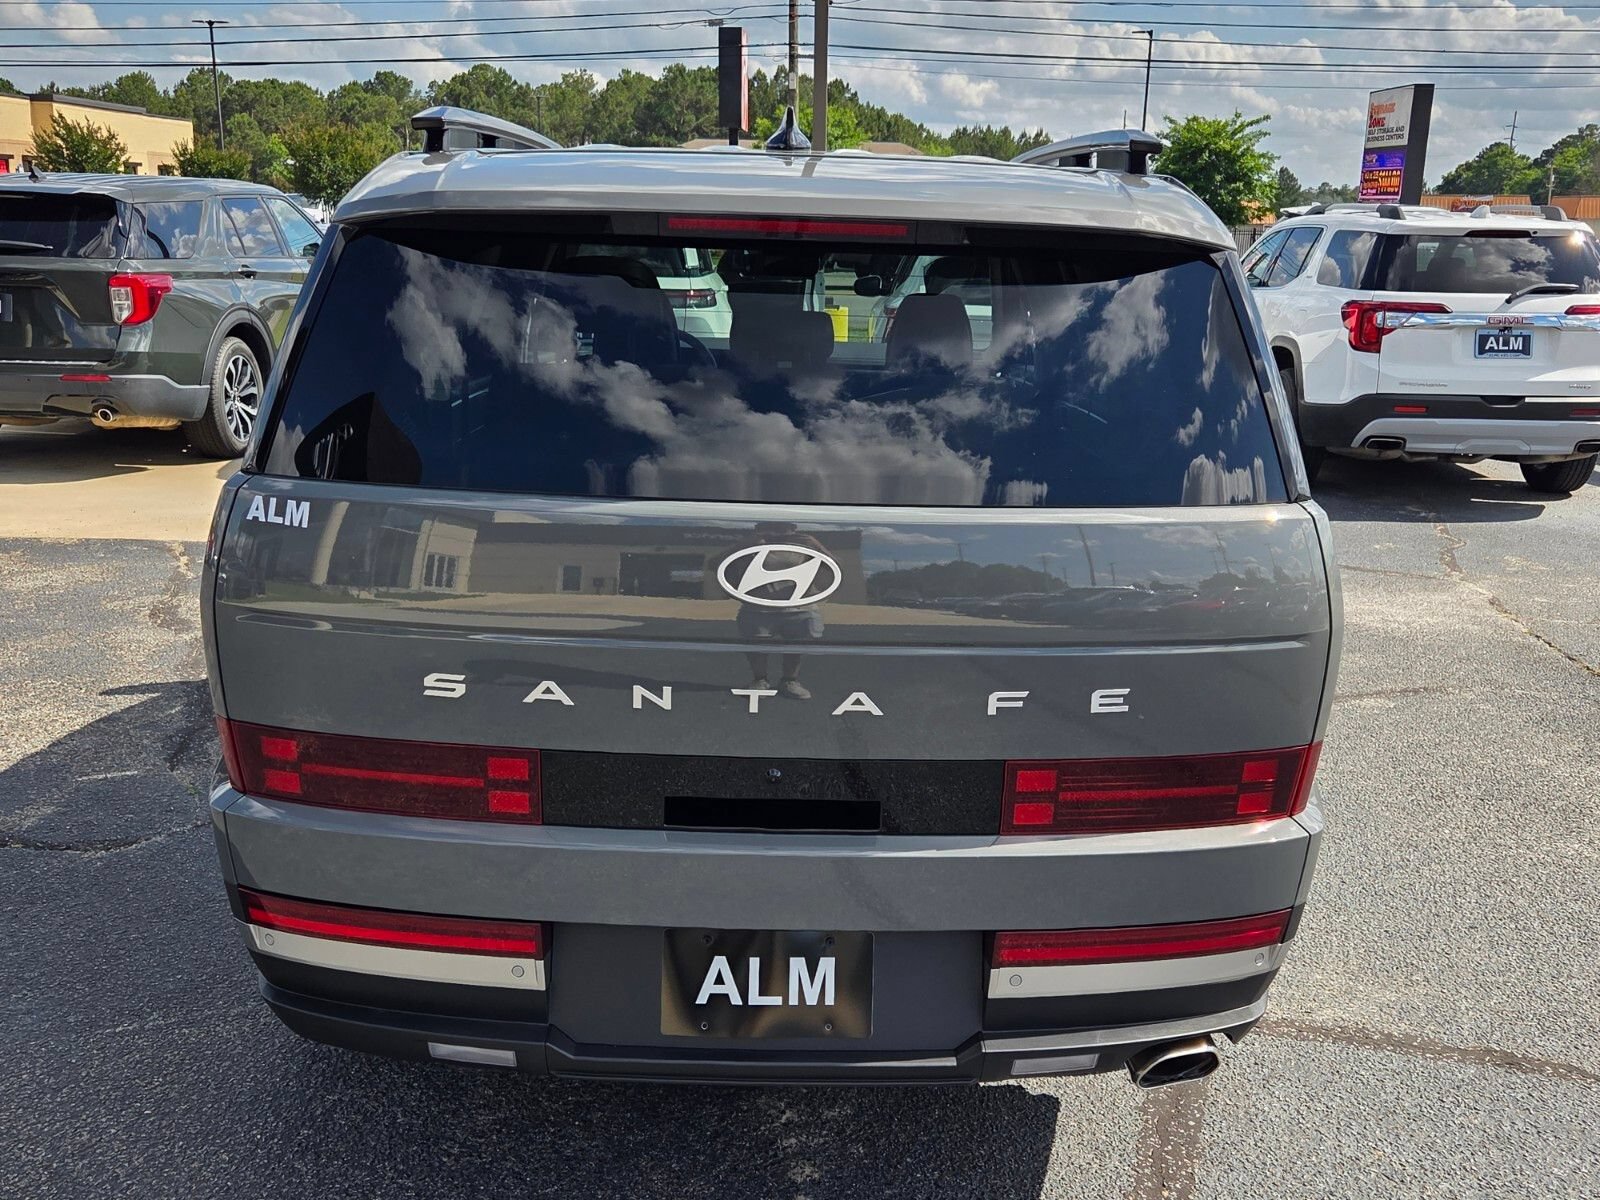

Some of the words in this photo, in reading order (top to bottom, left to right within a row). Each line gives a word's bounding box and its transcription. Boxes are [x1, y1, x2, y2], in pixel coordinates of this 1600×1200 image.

[1377, 126, 1395, 134] STORAGE
[1395, 125, 1405, 133] AND
[1367, 135, 1385, 143] BUSINESS
[1385, 133, 1405, 141] CENTERS
[1487, 316, 1535, 325] GMC
[1485, 336, 1523, 351] ALM
[246, 495, 310, 528] ALM
[423, 673, 884, 716] SANTA
[987, 687, 1132, 716] FE
[695, 955, 836, 1006] ALM
